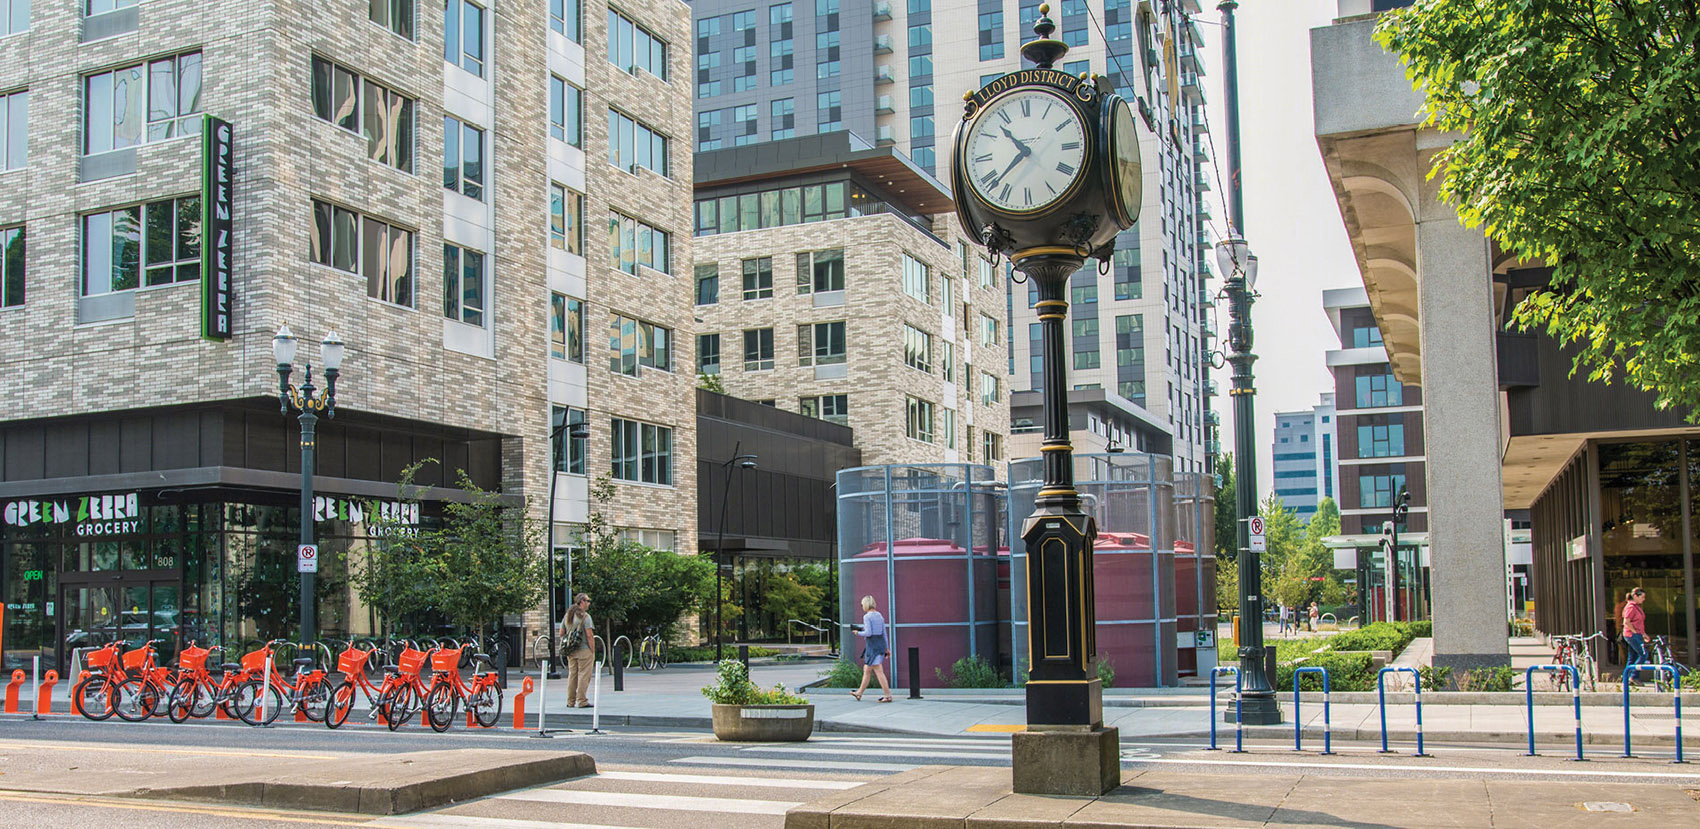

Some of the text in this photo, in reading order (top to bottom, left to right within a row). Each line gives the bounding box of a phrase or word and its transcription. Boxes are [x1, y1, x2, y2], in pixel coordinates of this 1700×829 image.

[978, 70, 1076, 101] LLOYD DISTRICT
[216, 125, 231, 334] GREEN ZEBRA
[4, 492, 139, 527] GREEN ZEBRA
[312, 496, 364, 522] REEN
[76, 520, 139, 536] GROCERY
[157, 556, 174, 567] 808
[24, 570, 44, 581] OPEN
